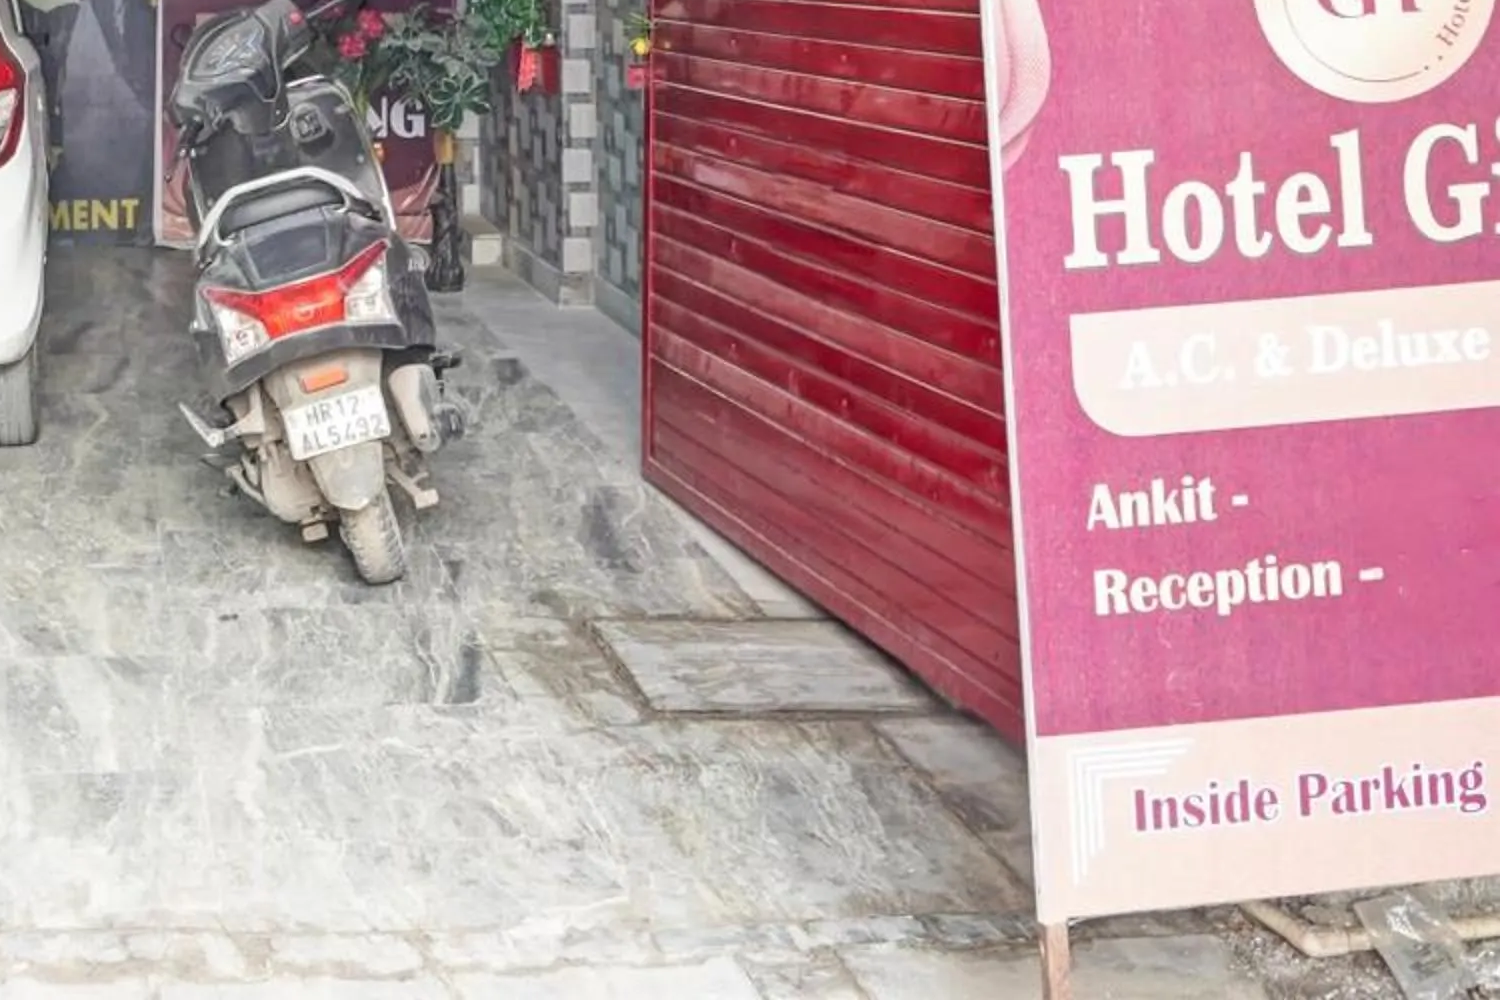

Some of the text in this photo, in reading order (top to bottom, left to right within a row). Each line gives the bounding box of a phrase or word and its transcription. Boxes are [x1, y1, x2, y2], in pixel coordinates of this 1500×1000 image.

[1058, 115, 1500, 270] Hotel G
[1118, 318, 1492, 391] A.C. & Deluxe
[1087, 474, 1218, 531] Ankit
[1093, 554, 1344, 616] Reception
[1133, 760, 1488, 832] Inside Parking
